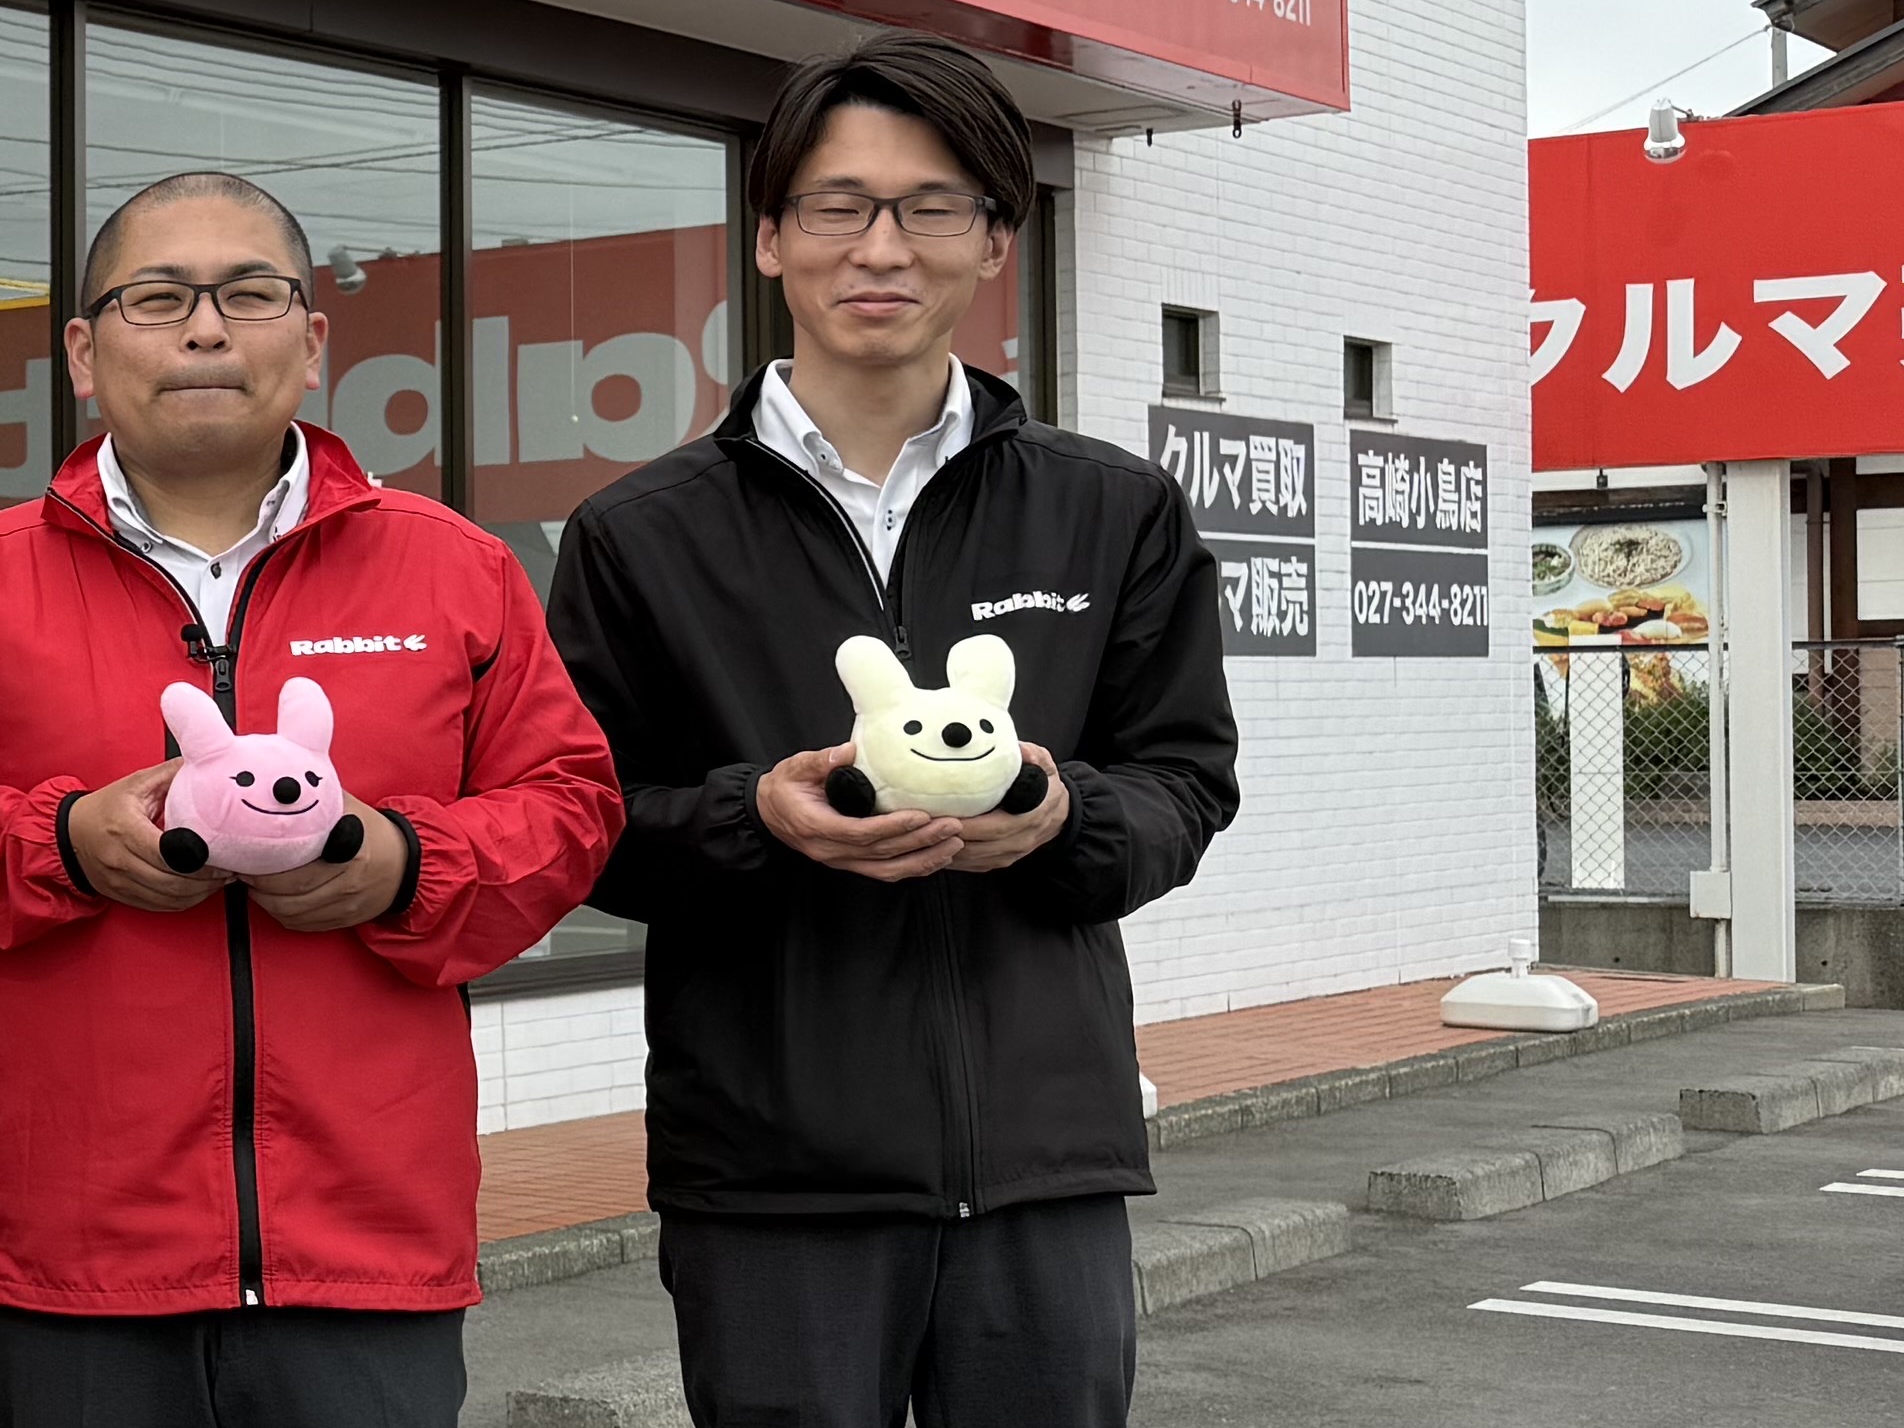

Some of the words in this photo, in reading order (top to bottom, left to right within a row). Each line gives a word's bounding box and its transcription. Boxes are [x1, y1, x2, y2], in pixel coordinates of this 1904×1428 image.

[1530, 265, 1904, 393] ルマ
[1160, 424, 1308, 518] クルマ買取
[970, 590, 1066, 621] Rabbit
[1220, 556, 1309, 638] マ販売
[1353, 580, 1489, 627] 027-344-8211
[290, 635, 402, 656] Rabbit
